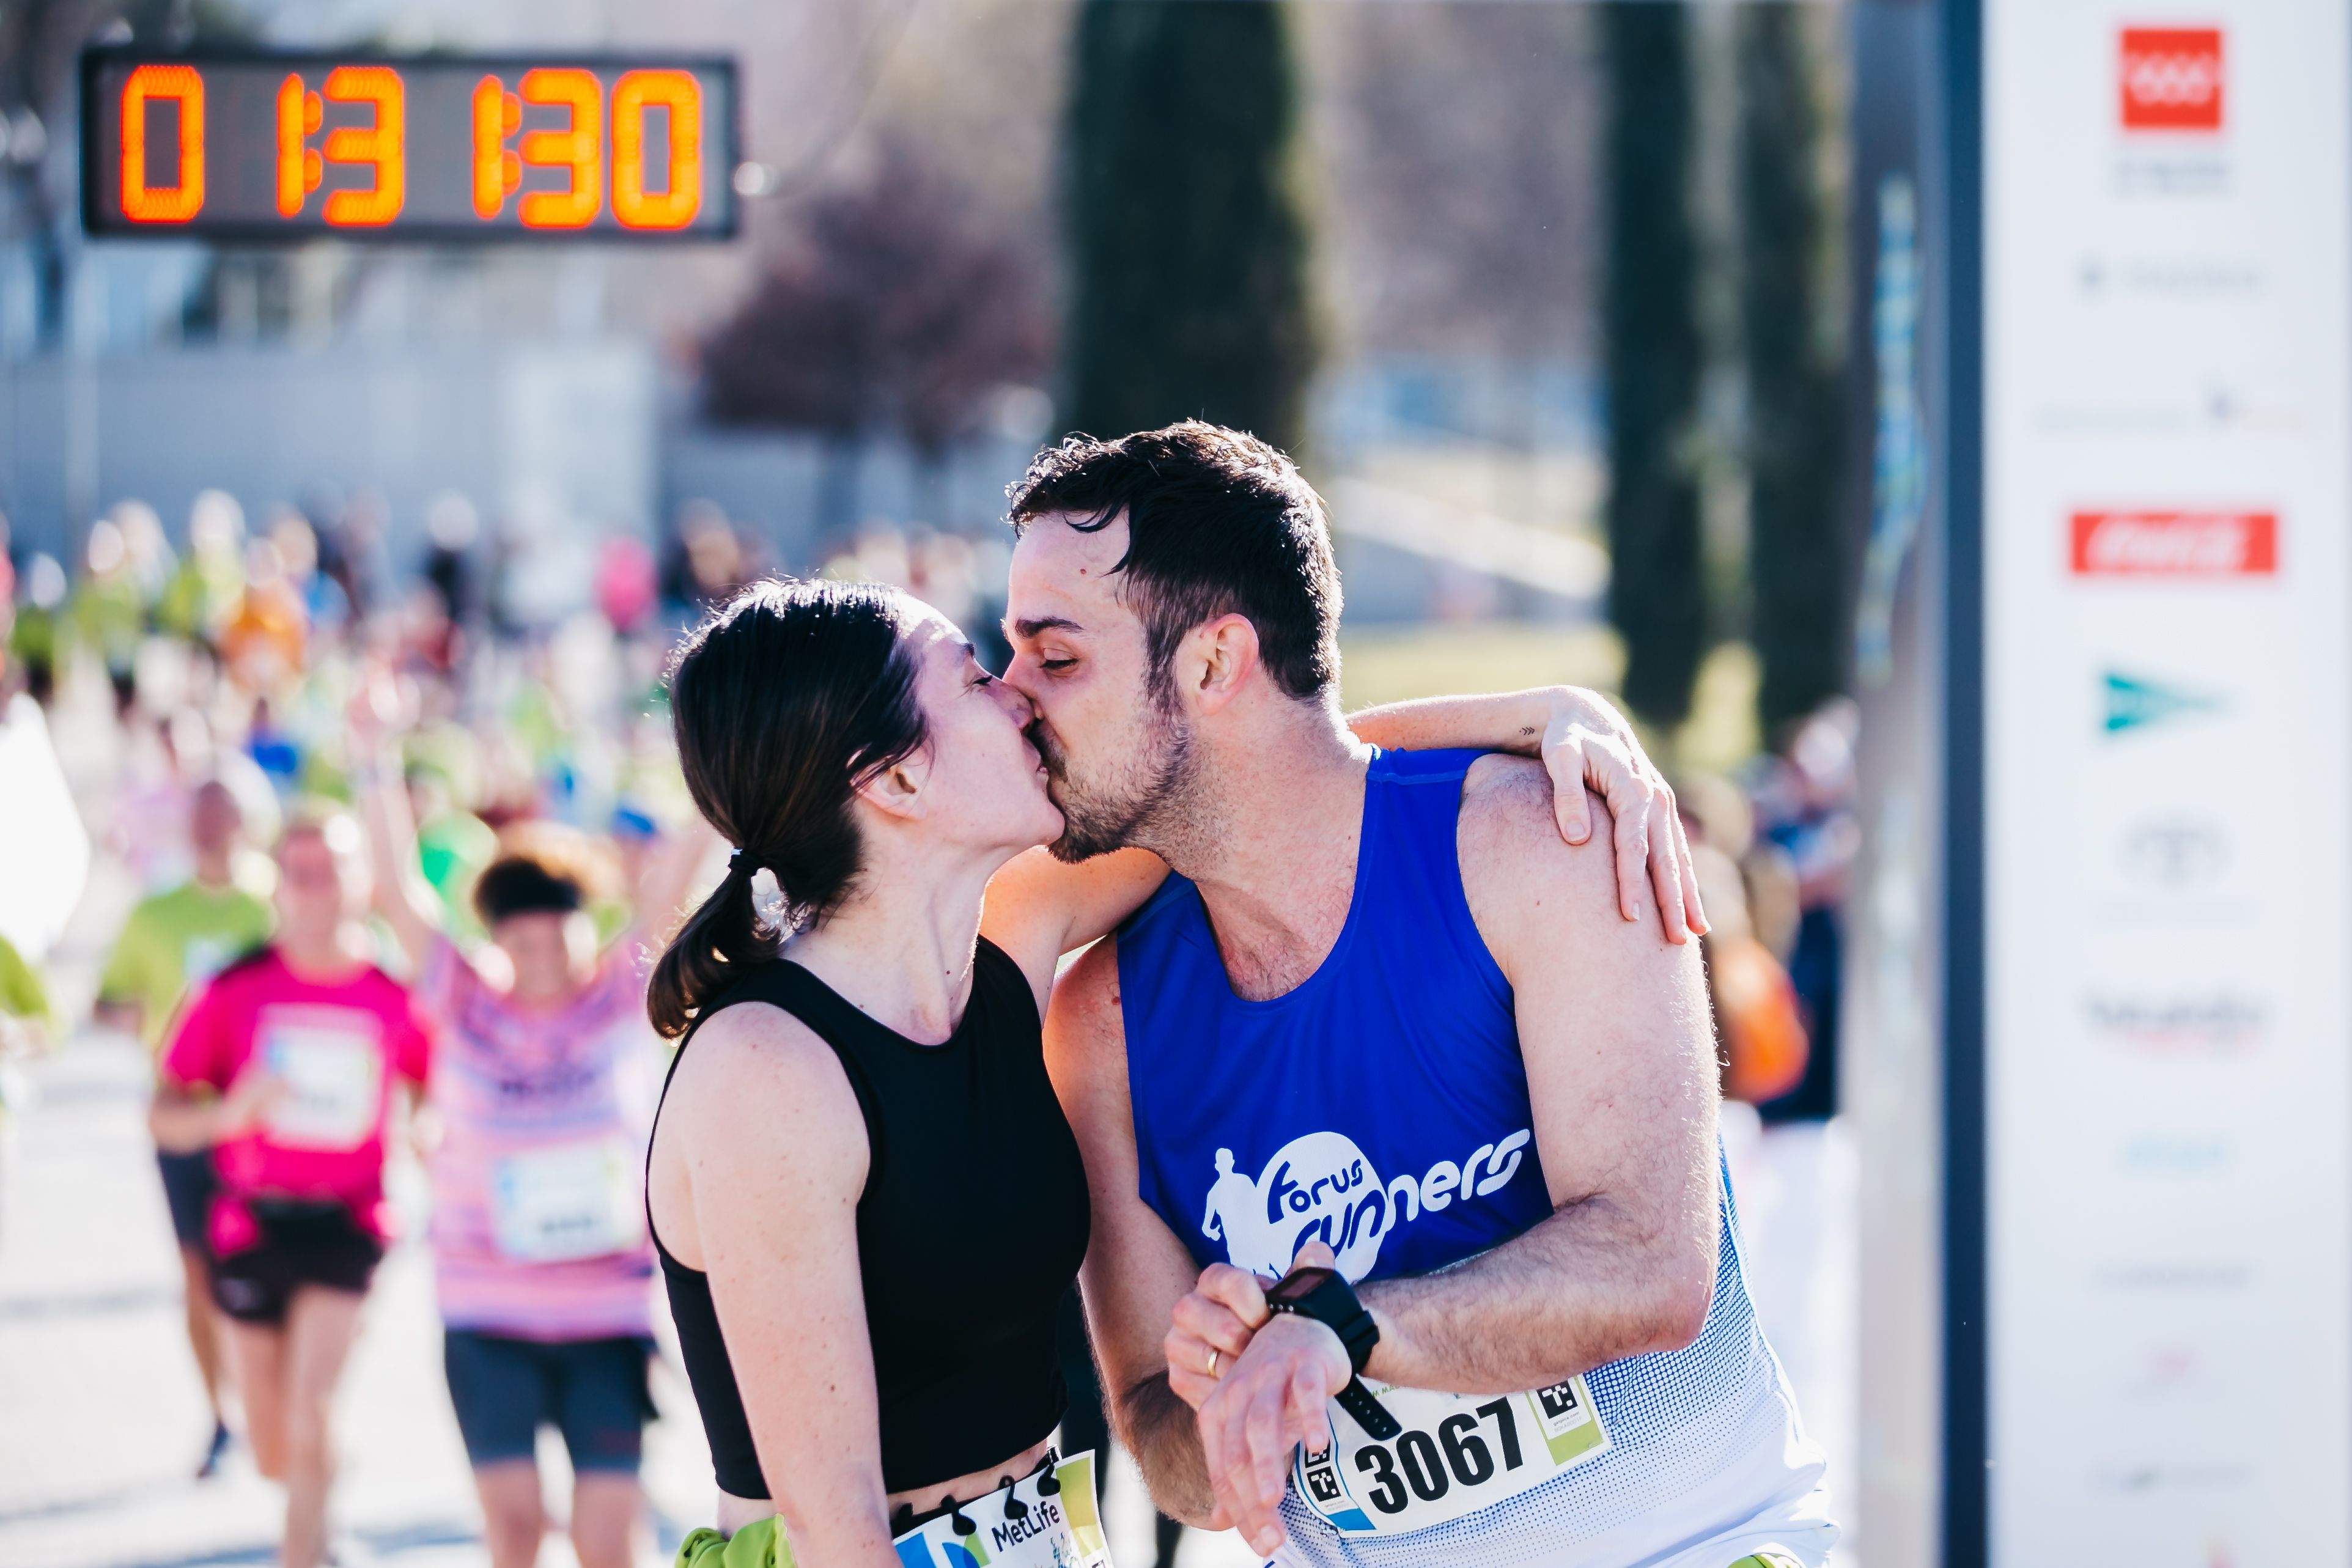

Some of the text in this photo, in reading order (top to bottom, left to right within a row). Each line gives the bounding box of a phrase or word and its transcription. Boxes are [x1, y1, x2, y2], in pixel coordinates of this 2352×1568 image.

[1291, 1129, 1530, 1264] runners
[1354, 1397, 1523, 1514] 3067
[991, 1501, 1060, 1552] MetLife
